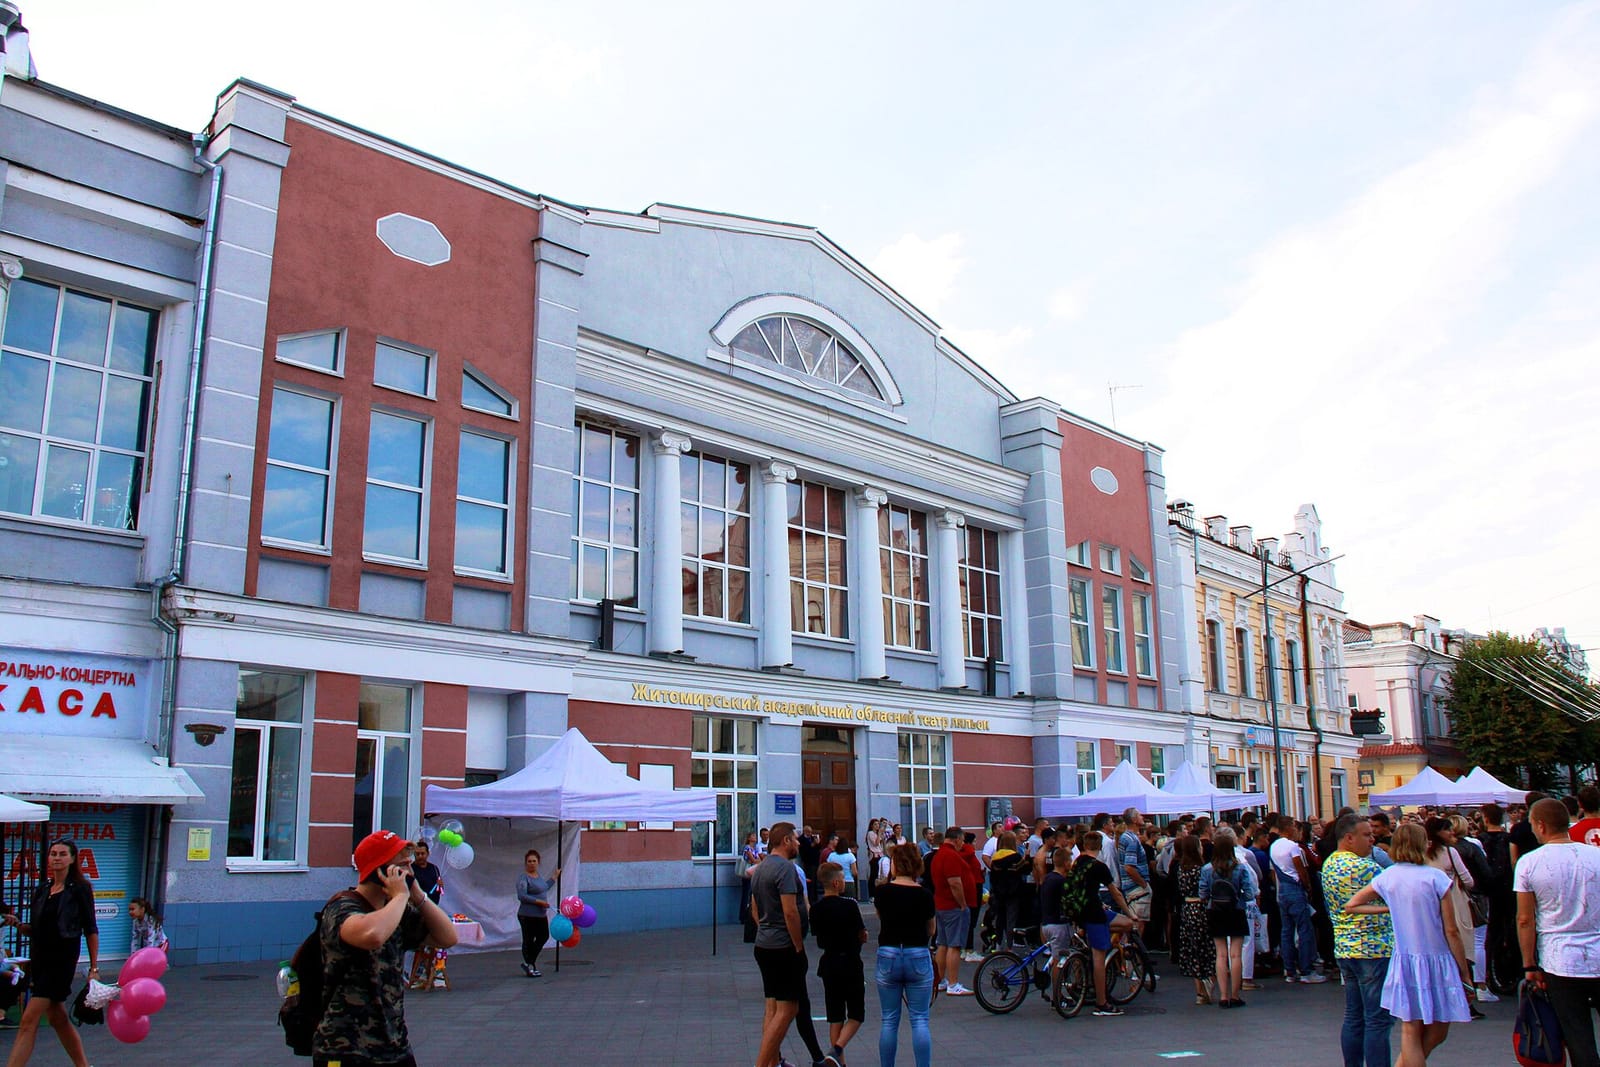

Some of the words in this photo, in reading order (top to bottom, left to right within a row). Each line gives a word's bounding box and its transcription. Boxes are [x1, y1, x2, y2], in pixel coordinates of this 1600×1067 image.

[632, 682, 760, 711] Житомирський
[763, 700, 853, 720] академічний
[856, 704, 915, 725] обласний
[917, 714, 948, 731] театр
